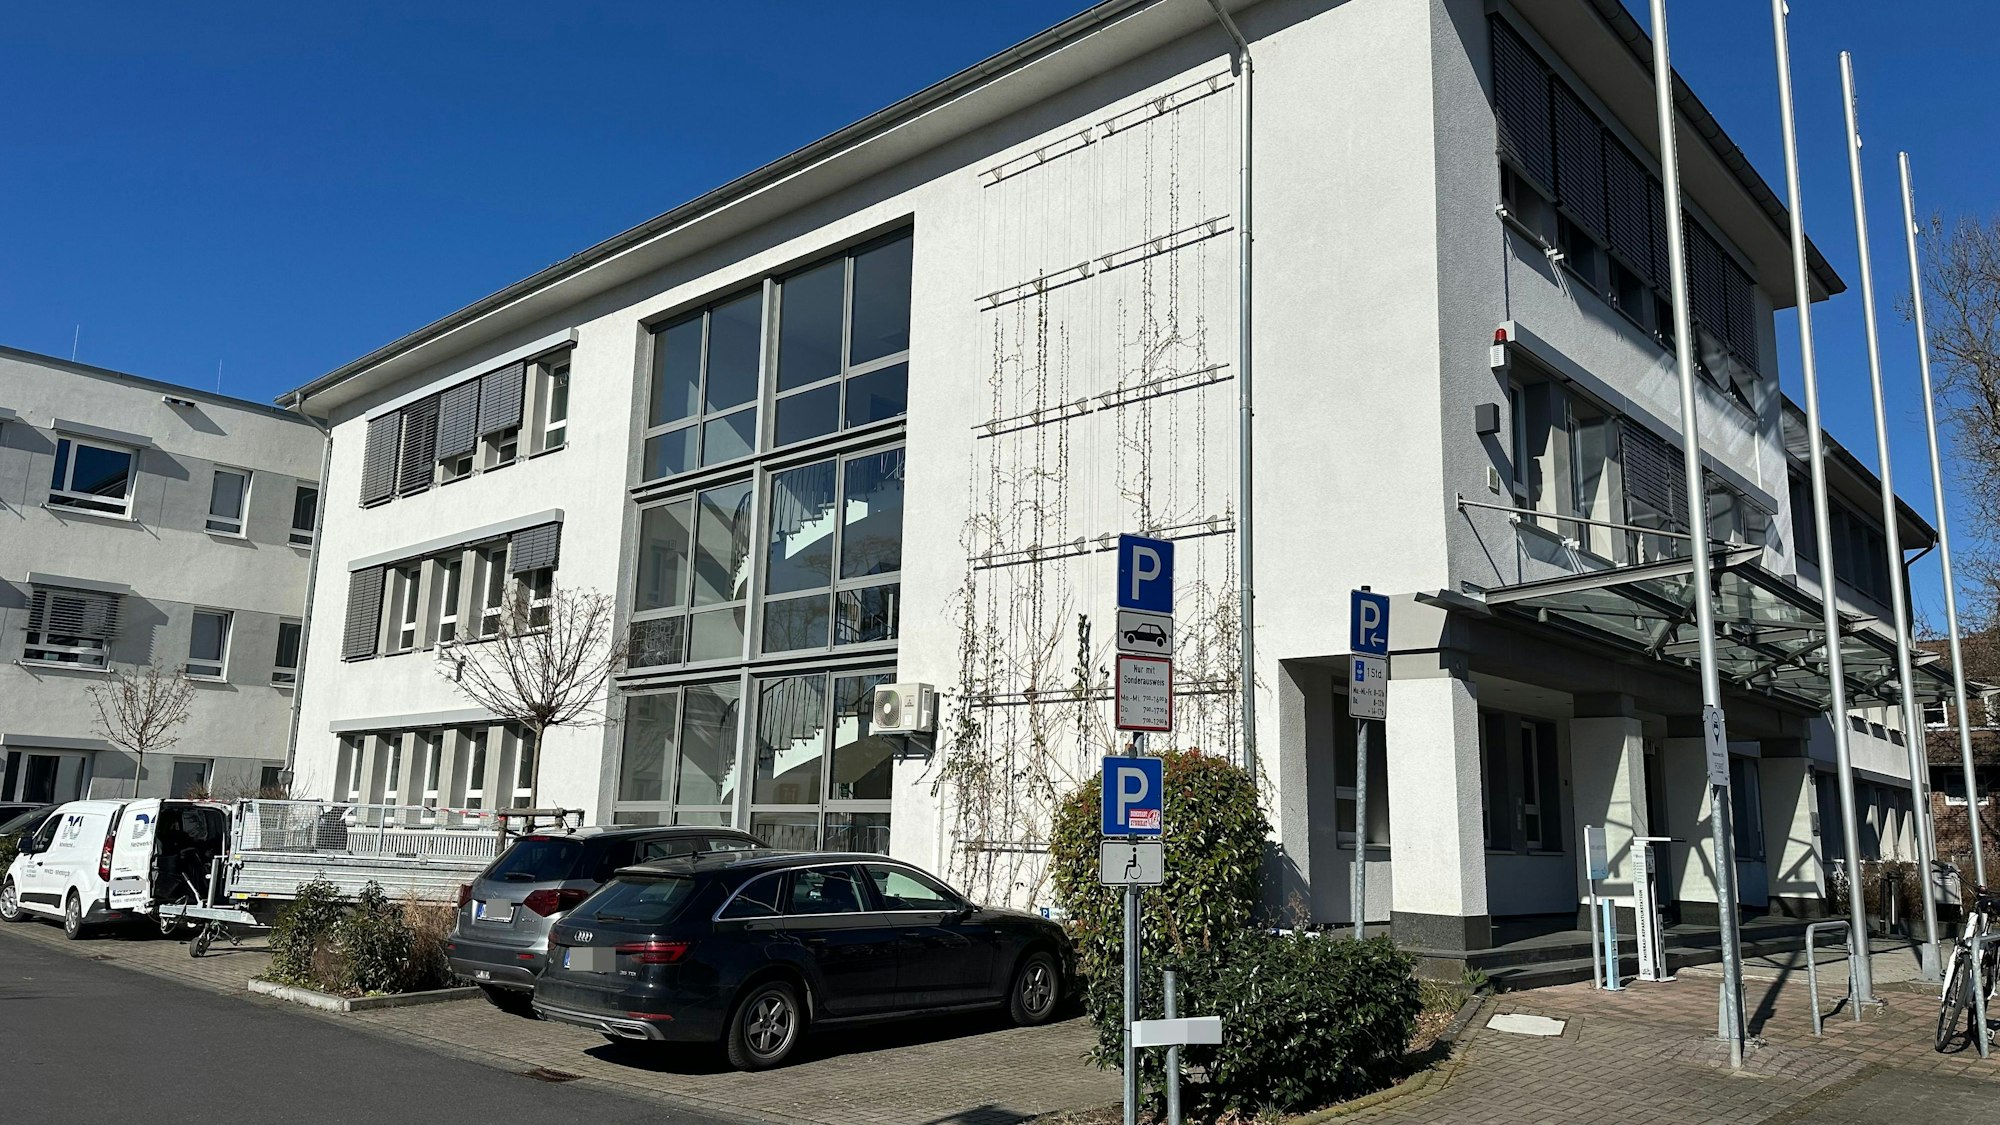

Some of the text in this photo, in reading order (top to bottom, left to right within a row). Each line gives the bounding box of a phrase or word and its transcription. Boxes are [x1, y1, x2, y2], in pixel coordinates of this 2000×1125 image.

[1131, 545, 1161, 600] P
[1360, 599, 1380, 645] P
[1123, 675, 1165, 686] Sonderausweis
[1133, 664, 1156, 675] Nur mit
[1117, 766, 1149, 825] P
